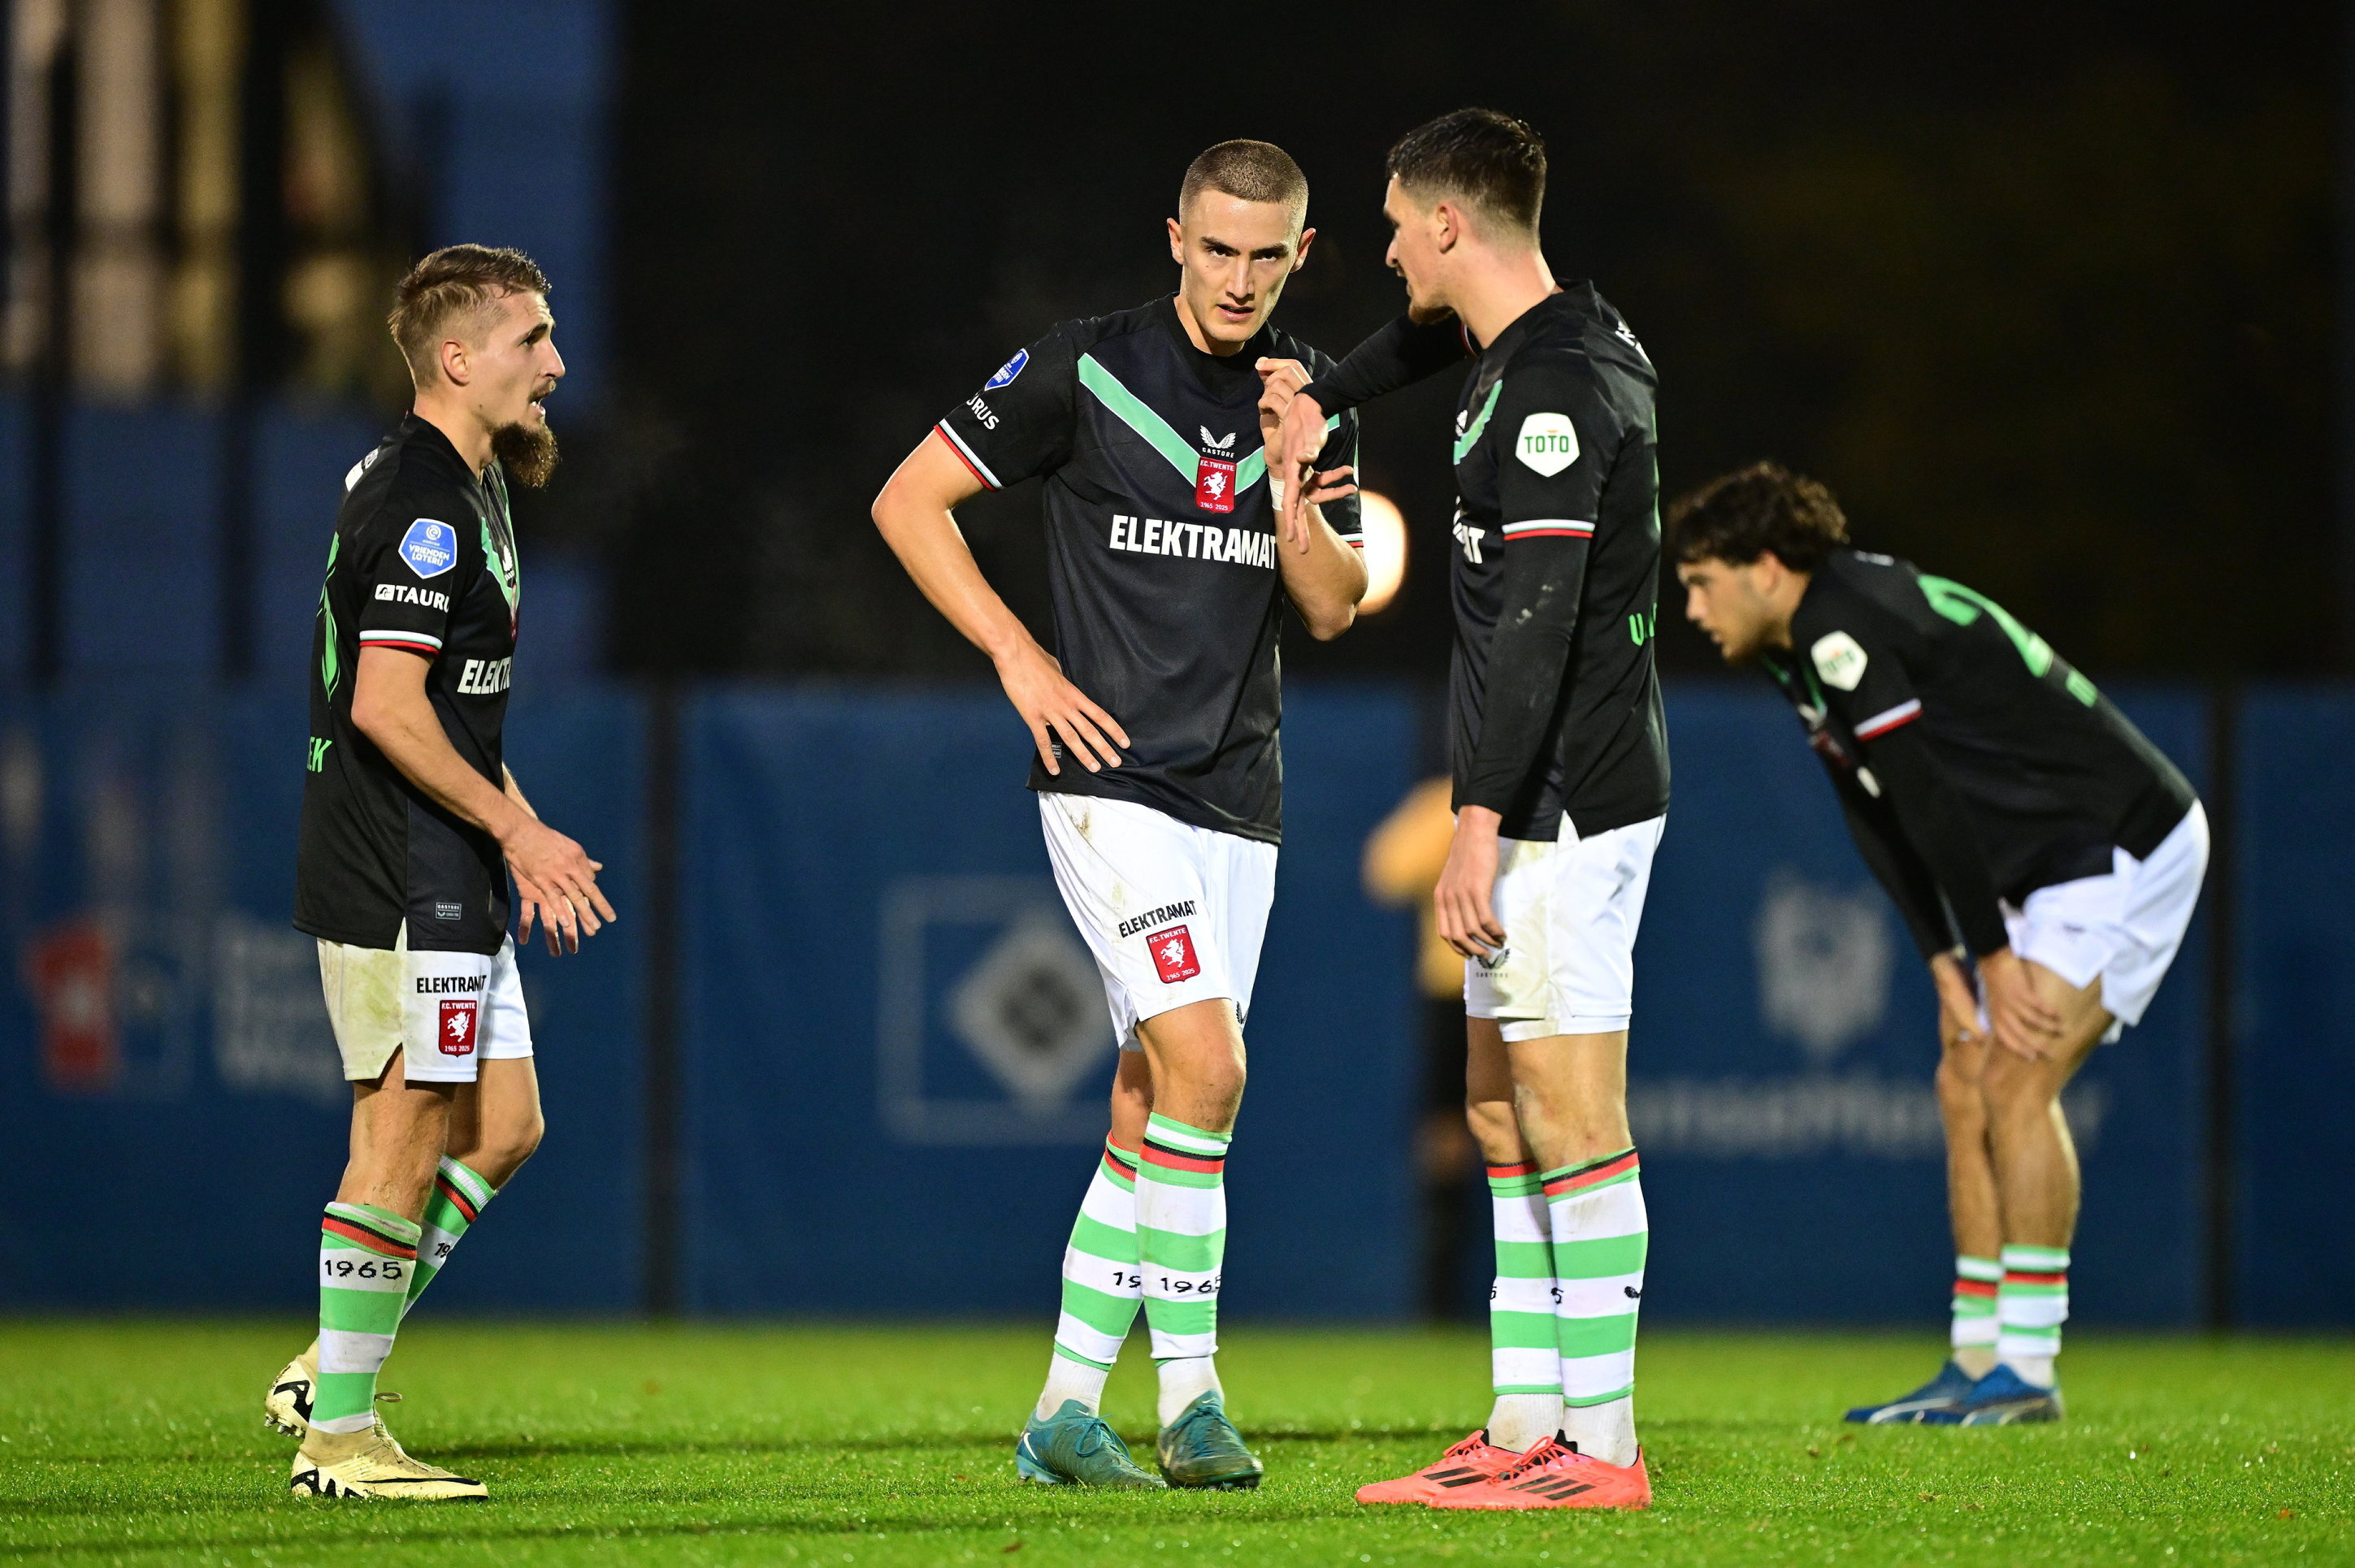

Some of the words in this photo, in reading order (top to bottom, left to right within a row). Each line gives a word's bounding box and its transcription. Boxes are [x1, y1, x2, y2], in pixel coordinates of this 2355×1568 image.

[1524, 435, 1569, 453] TOTO
[1202, 447, 1235, 458] CASTORE
[1209, 461, 1235, 471] TWENTE
[1200, 501, 1213, 509] 1965
[1109, 514, 1276, 570] ELEKTRAMAT
[409, 544, 450, 561] VRIENDEN
[1118, 900, 1197, 938] ELEKTRAMAT
[1160, 928, 1186, 940] TWENTE
[1166, 972, 1181, 981] 1965
[1182, 968, 1195, 977] 2025
[324, 1259, 402, 1280] 1965
